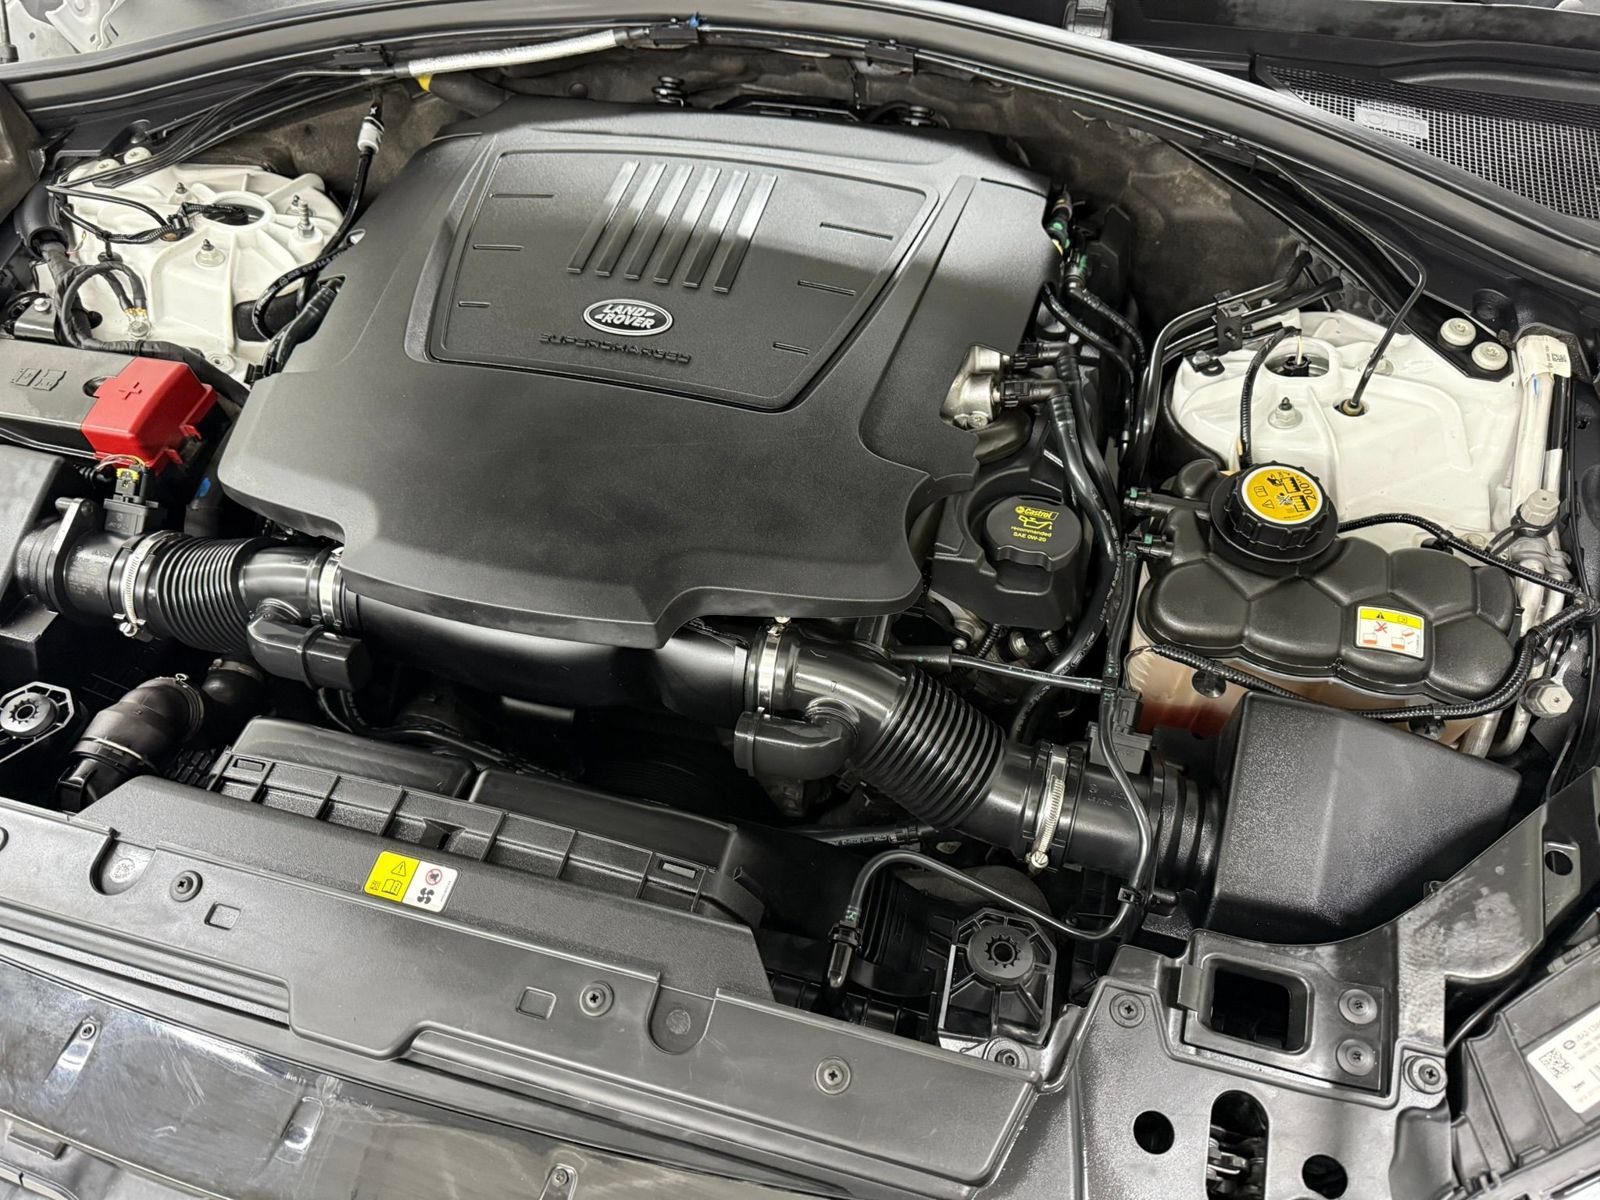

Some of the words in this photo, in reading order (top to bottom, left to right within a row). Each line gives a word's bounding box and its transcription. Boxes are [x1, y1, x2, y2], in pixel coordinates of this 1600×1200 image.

[602, 303, 647, 317] LAND
[601, 313, 656, 329] ROVER
[539, 333, 691, 364] SUPERCHARGED
[1024, 507, 1053, 519] Castrol
[1010, 526, 1052, 538] recommended
[1013, 531, 1027, 539] SAE
